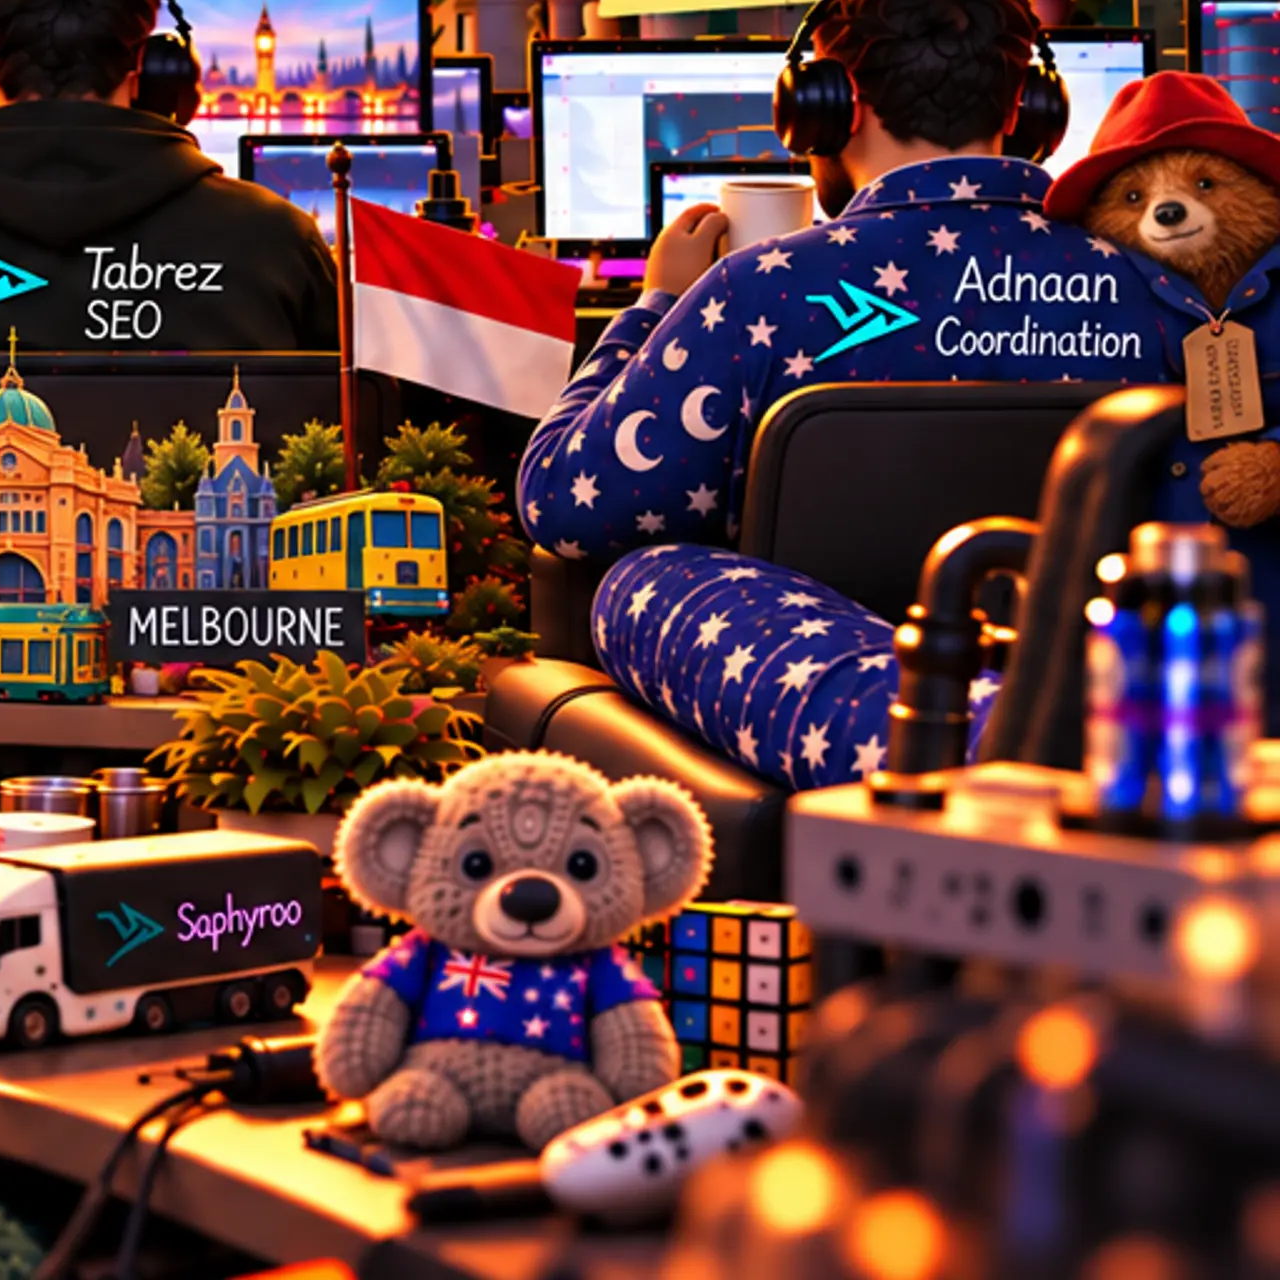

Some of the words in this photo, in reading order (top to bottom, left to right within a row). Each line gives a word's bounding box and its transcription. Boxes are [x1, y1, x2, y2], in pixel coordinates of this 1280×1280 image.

[85, 244, 222, 290] Tabrez
[955, 255, 1117, 302] Adnaan
[85, 300, 161, 339] SEO
[936, 315, 1140, 358] Coordination
[130, 607, 343, 646] MELBOURNE
[178, 893, 301, 951] Saphyroo
